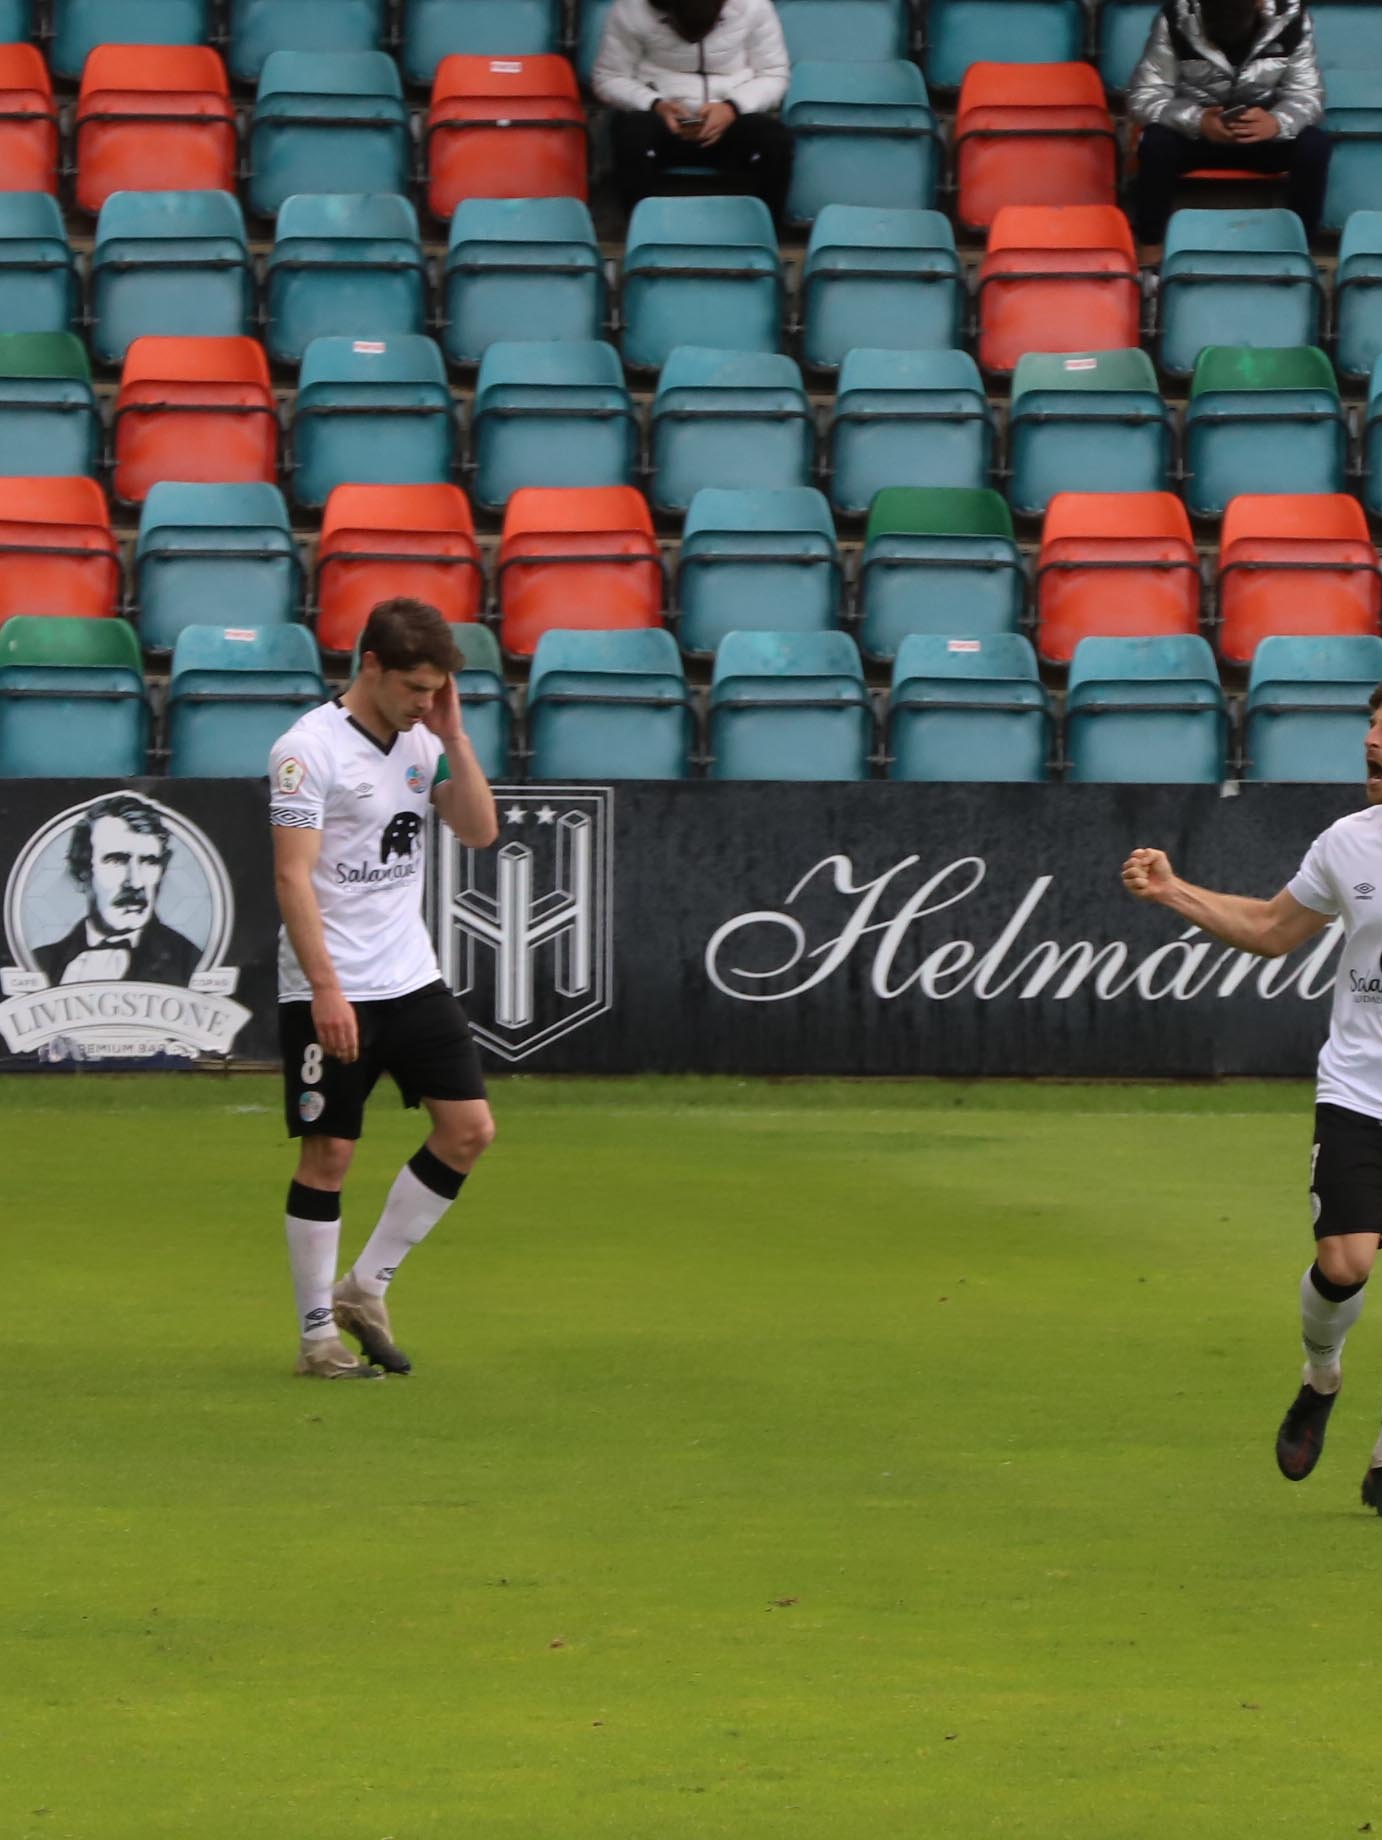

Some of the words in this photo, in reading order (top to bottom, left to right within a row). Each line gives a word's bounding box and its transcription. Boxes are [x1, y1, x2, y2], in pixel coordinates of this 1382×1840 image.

[705, 854, 1345, 1000] Helmánt
[9, 991, 230, 1037] LIVINGSTONE
[301, 1043, 323, 1085] 8
